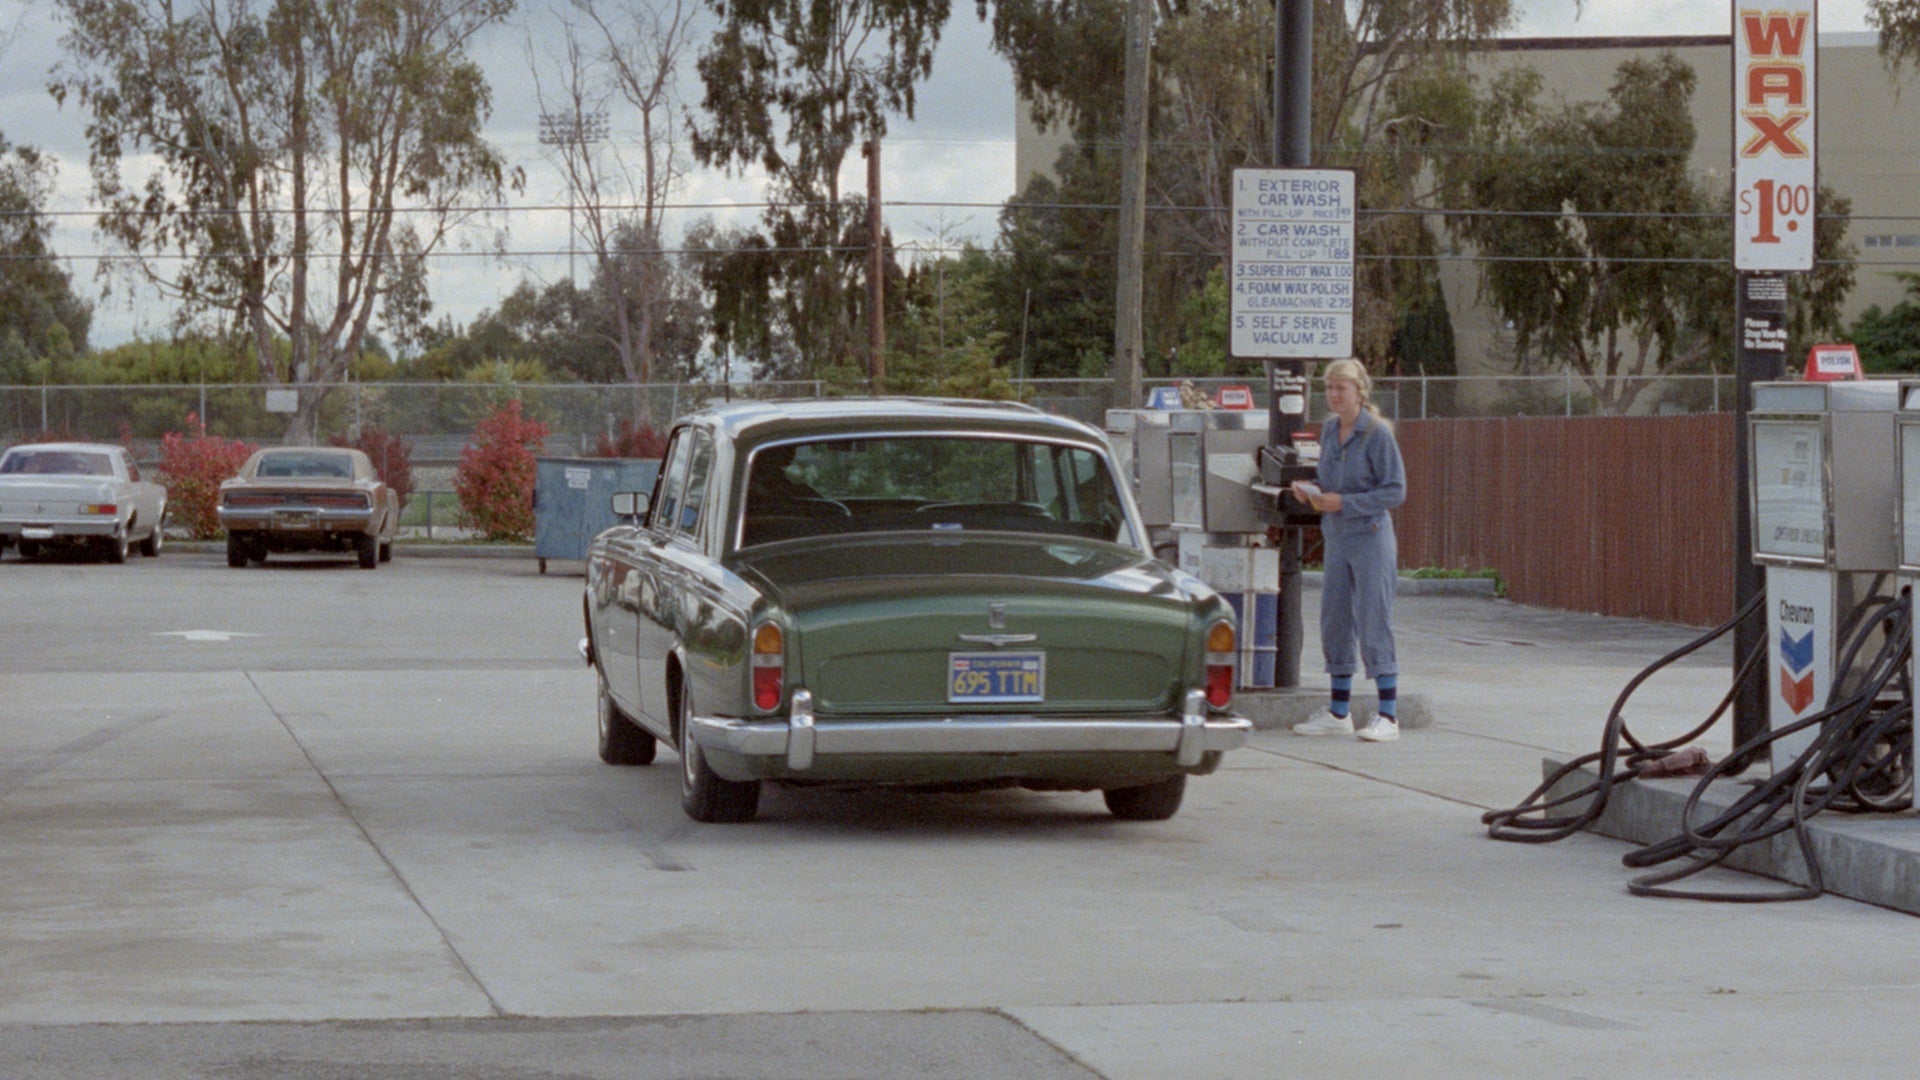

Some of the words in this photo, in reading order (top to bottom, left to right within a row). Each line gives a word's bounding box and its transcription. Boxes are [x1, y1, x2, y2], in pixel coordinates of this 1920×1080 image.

[1740, 9, 1810, 159] WAX
[1258, 179, 1340, 192] EXTERIOR
[1258, 193, 1288, 206] CAR
[1291, 194, 1341, 207] WASH
[1238, 208, 1260, 218] WITH
[1257, 224, 1289, 236] CAR
[1293, 224, 1341, 237] WASH
[1239, 238, 1289, 248] WITHOUT
[1292, 238, 1350, 249] COMPLETE
[1249, 265, 1284, 277] SUPER
[1286, 265, 1307, 277] HOT
[1310, 265, 1332, 277] WAX
[1248, 282, 1281, 294] FOAM
[1284, 283, 1308, 295] WAX
[1310, 283, 1350, 295] POLISH
[1252, 316, 1288, 329] SELF
[1293, 316, 1337, 330] SERVE
[1253, 331, 1314, 344] VACUUM
[1779, 599, 1815, 625] Chevron
[954, 670, 991, 694] 695
[996, 670, 1038, 694] TTM
